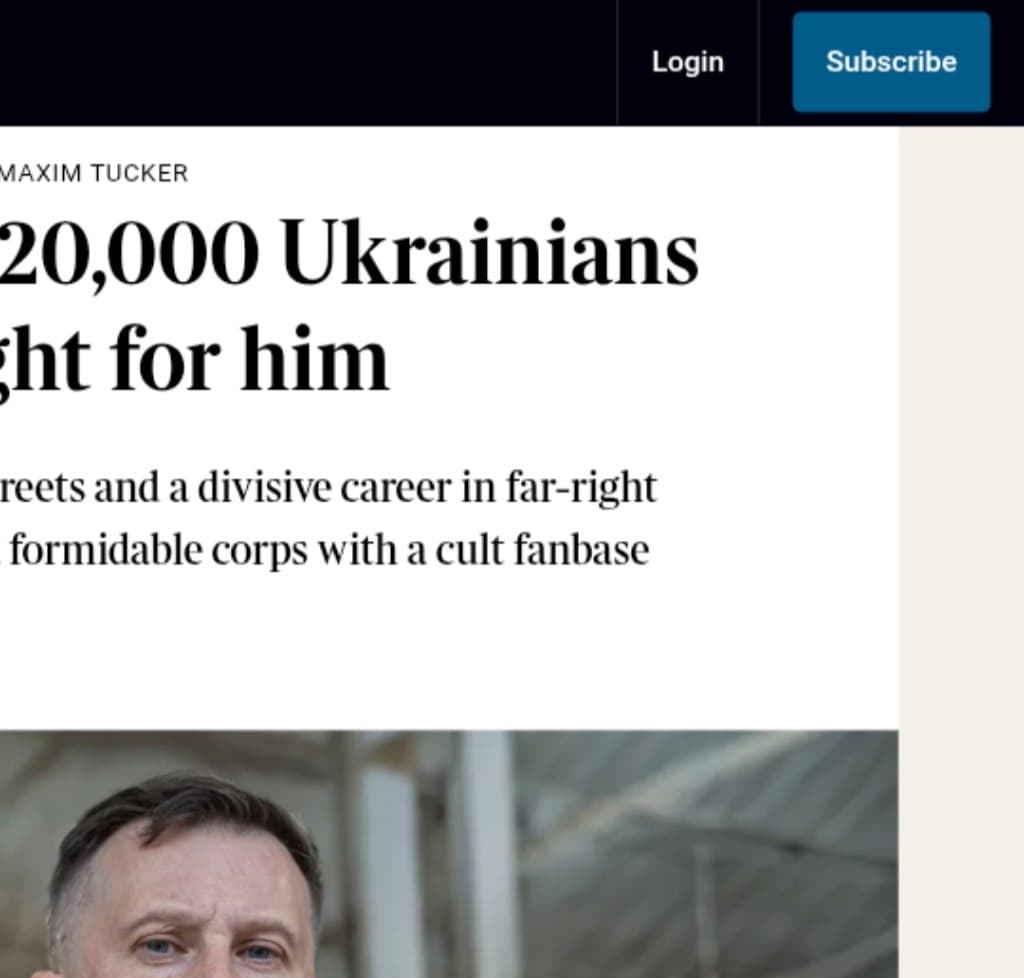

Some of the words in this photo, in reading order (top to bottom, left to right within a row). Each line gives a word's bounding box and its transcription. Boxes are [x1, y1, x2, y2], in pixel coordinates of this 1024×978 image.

[653, 50, 724, 78] Login
[827, 50, 957, 72] Subscribe
[90, 164, 187, 182] TUCKER
[280, 217, 698, 286] Ukrainians
[109, 323, 221, 392] for
[240, 323, 390, 391] him
[95, 469, 160, 502] and
[170, 479, 189, 502] a
[198, 469, 332, 502] divisive
[341, 479, 452, 502] career
[462, 469, 496, 502] in
[506, 469, 658, 510] far-right
[10, 532, 203, 565] formidable
[212, 541, 308, 573] corps
[318, 532, 397, 565] with
[407, 541, 427, 565] a
[436, 532, 504, 565] cult
[514, 532, 649, 565] fanbase
